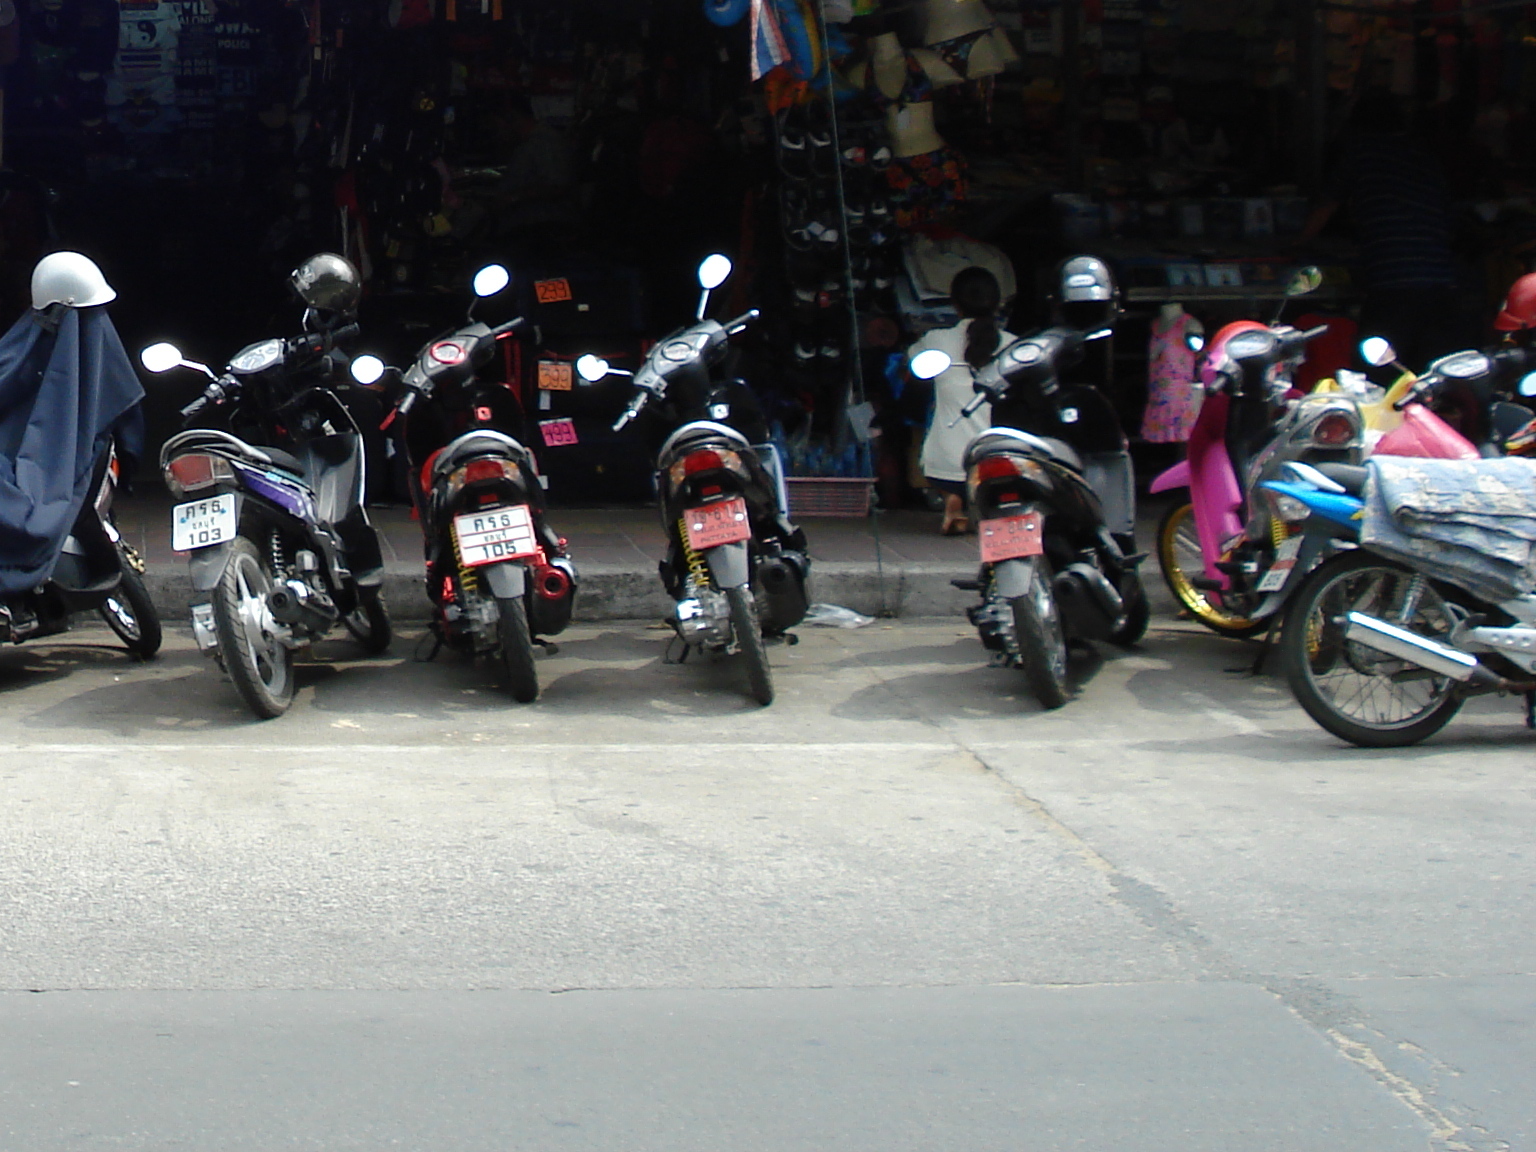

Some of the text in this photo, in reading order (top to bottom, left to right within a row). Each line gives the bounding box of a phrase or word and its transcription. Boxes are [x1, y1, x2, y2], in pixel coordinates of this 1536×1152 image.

[538, 281, 568, 300] 299
[189, 528, 221, 545] 103
[482, 541, 517, 559] 105
